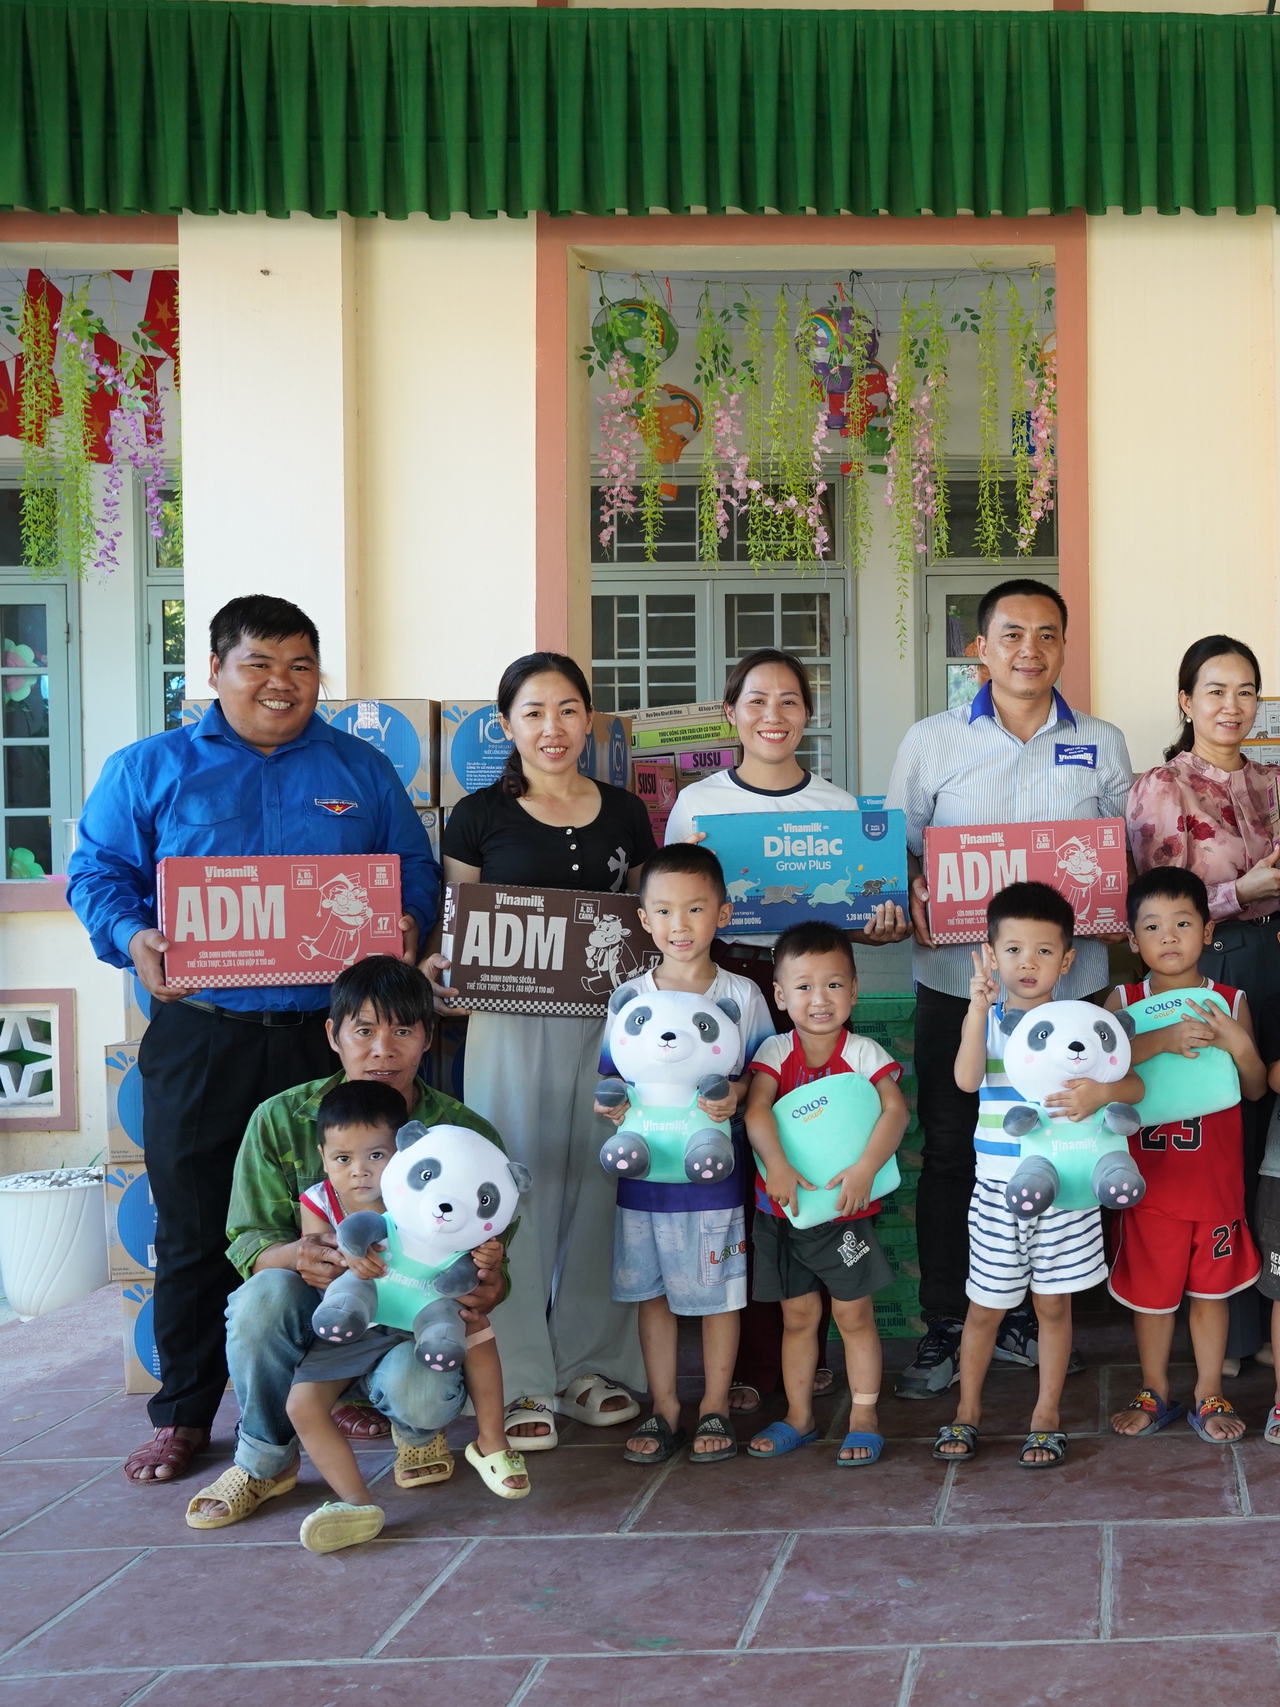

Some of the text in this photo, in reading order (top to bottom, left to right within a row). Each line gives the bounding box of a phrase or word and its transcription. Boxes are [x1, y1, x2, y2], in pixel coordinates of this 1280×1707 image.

[479, 718, 506, 743] IC
[692, 751, 721, 768] SUSU
[638, 772, 656, 795] SUSU
[783, 822, 823, 833] Vinamilk
[763, 835, 843, 858] Dielac
[959, 832, 1004, 845] Vinamilk
[205, 865, 258, 879] Vinamilk
[775, 859, 832, 872] Grow Plus
[936, 849, 1028, 903] ADM
[495, 892, 545, 908] Vinamilk
[174, 884, 286, 942] ADM
[460, 910, 568, 971] ADM
[1144, 998, 1182, 1015] COLOS
[854, 1022, 888, 1033] namilk
[791, 1096, 829, 1119] COLOS
[642, 1119, 688, 1133] Vinamilk
[1139, 1116, 1202, 1151] 23
[1051, 1136, 1098, 1151] Vinamilk
